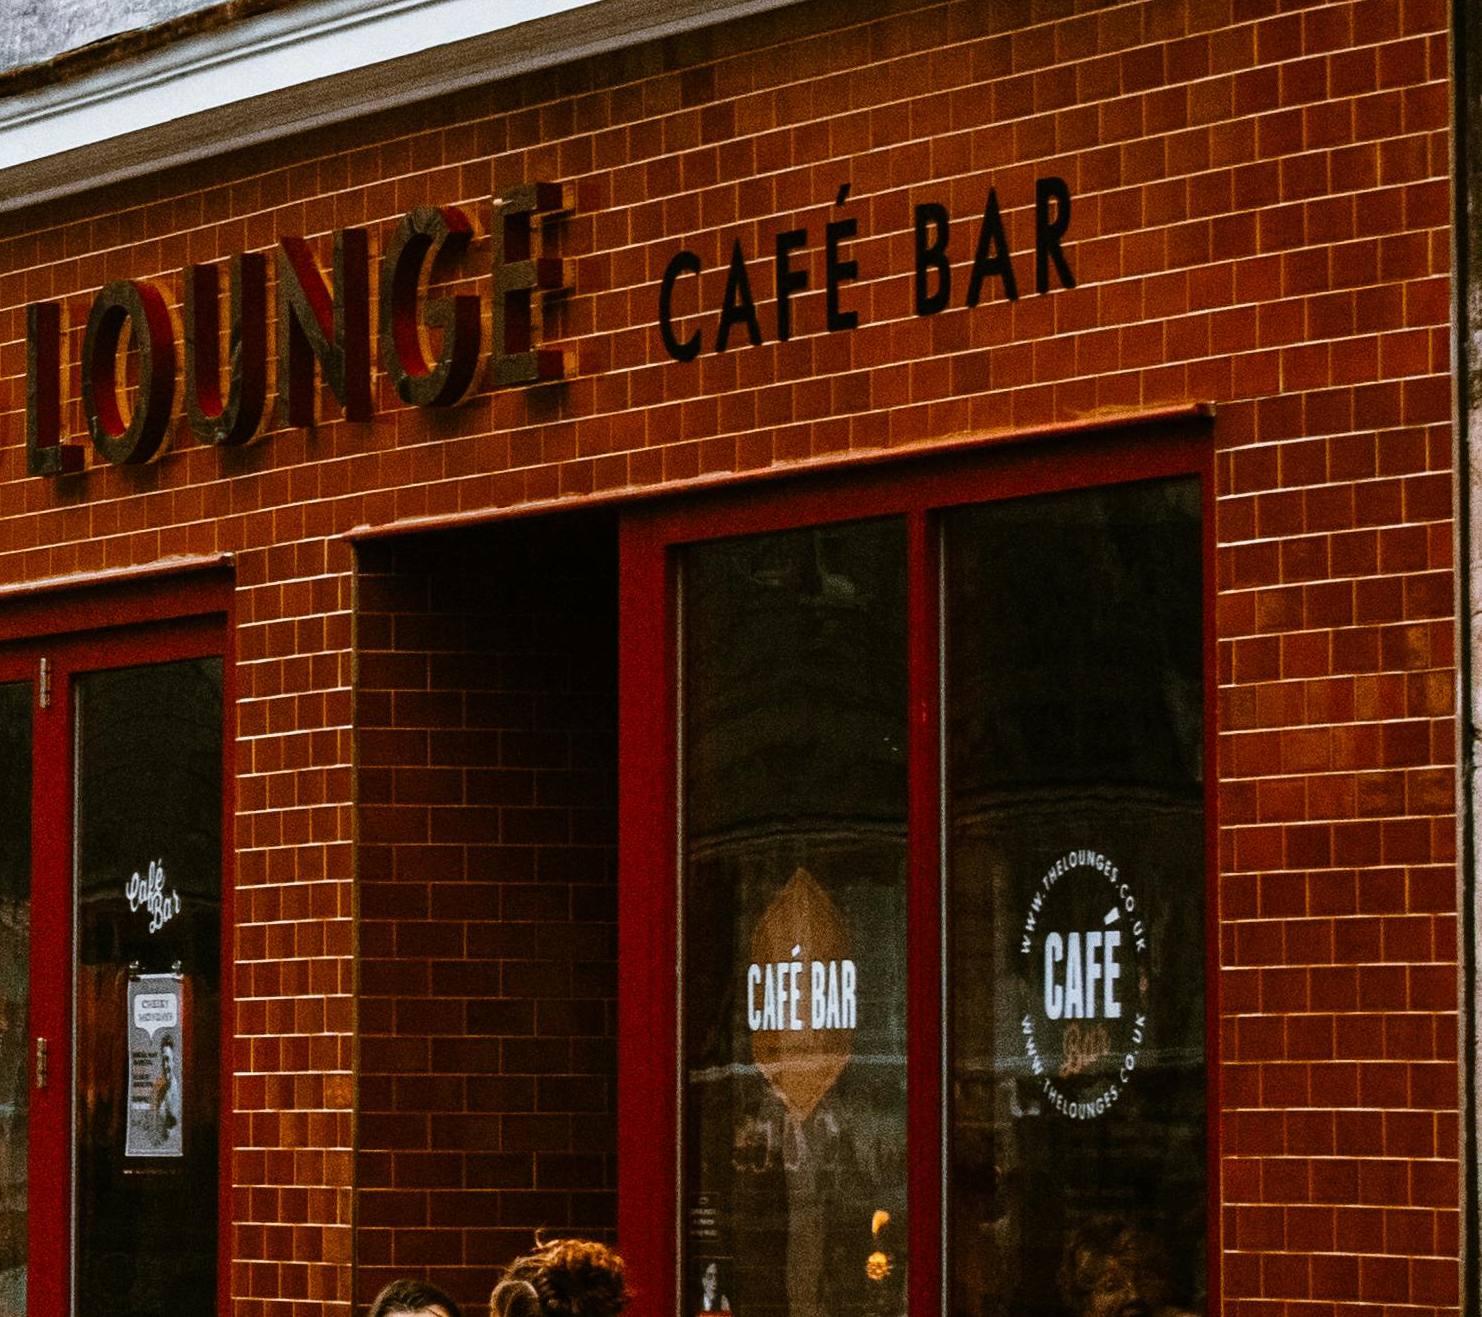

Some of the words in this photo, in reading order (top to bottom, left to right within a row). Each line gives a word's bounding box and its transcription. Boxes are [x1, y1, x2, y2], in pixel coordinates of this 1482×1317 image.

[27, 181, 567, 480] LOUNGE
[657, 183, 860, 364] CAFÉ
[913, 175, 1078, 317] BAR
[746, 943, 803, 1031] CAFÉ
[811, 958, 857, 1030] BAR
[1043, 906, 1122, 1021] CAFÉ
